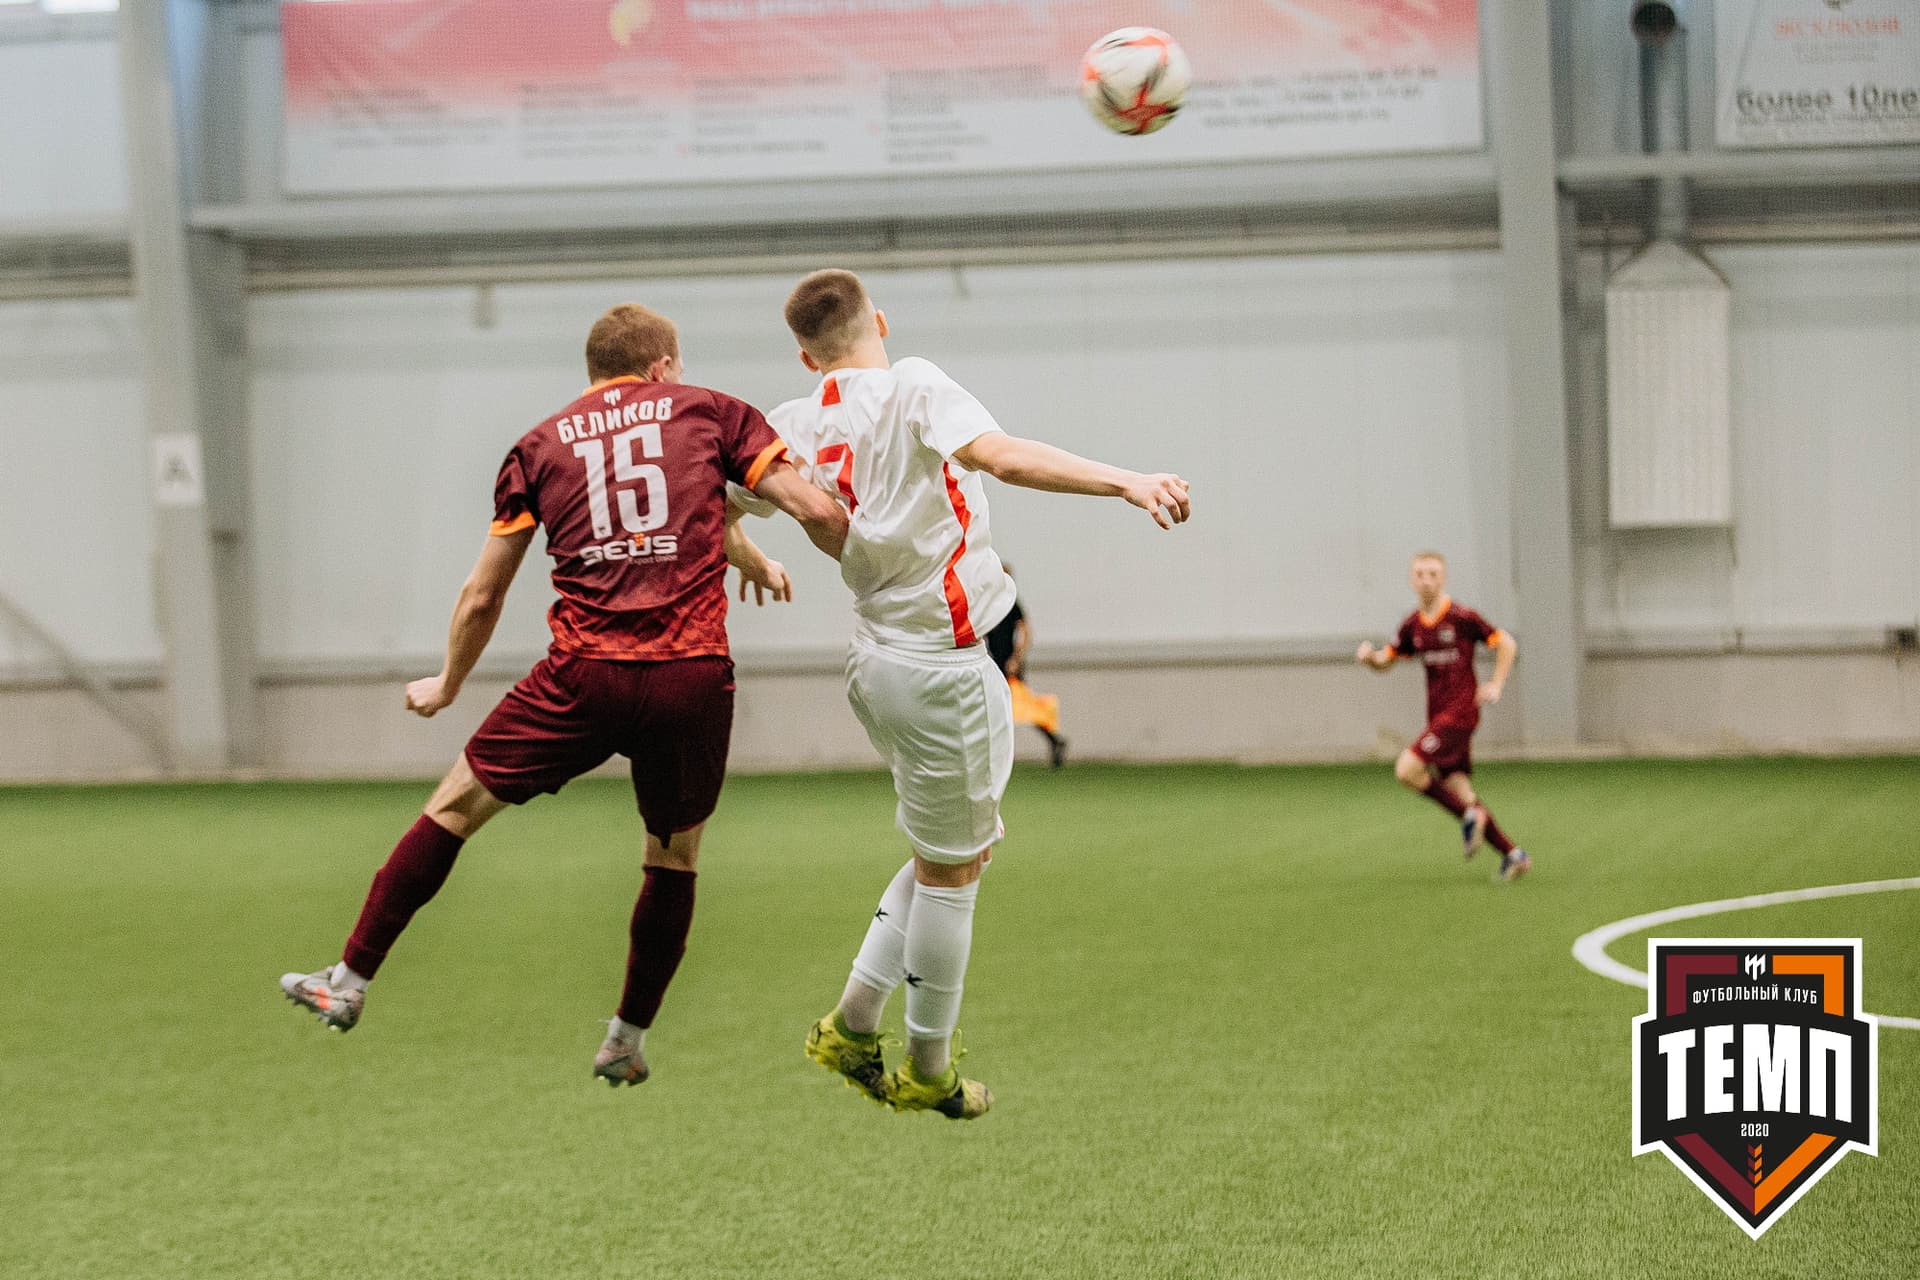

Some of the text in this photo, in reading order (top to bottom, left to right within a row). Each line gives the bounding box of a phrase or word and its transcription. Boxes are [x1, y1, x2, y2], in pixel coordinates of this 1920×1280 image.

[556, 396, 674, 444] БЕЛИКОВ
[572, 423, 670, 540] 15
[816, 442, 859, 514] 7
